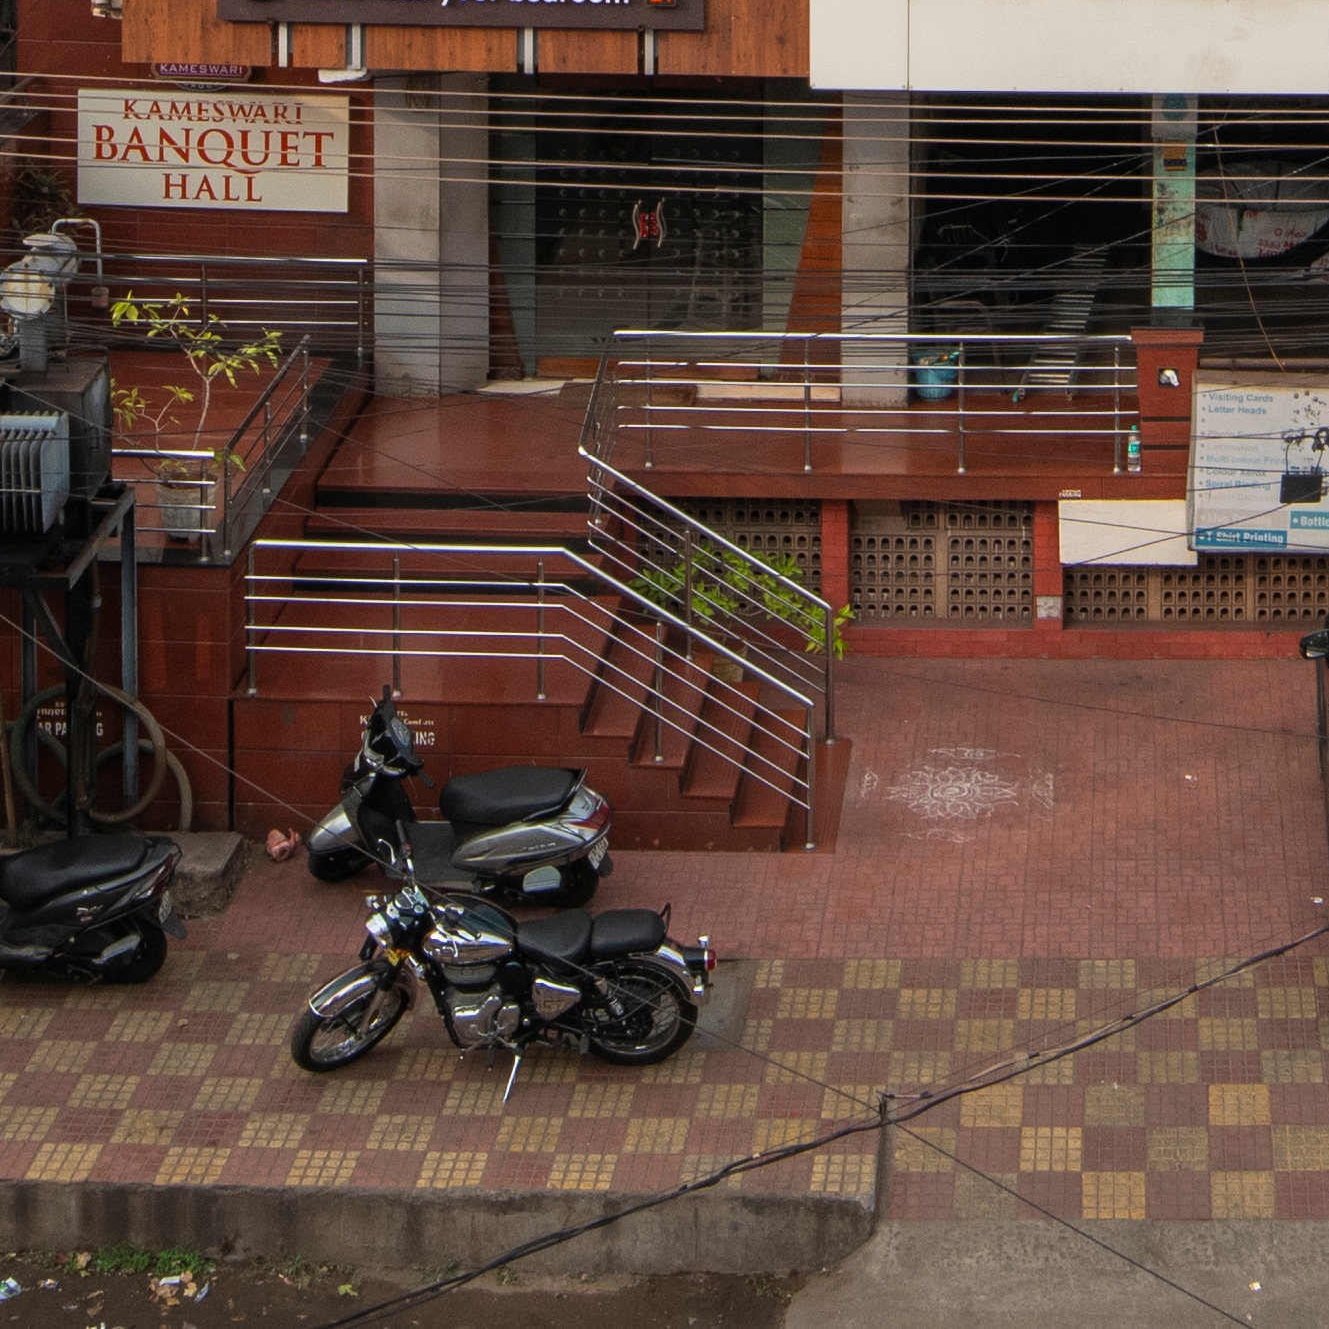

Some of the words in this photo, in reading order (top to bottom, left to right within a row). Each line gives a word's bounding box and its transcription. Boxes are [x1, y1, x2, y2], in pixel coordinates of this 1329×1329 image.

[160, 64, 242, 77] KAMESWARI
[123, 97, 304, 125] KAMESWARI
[92, 125, 335, 173] BANQUET
[163, 173, 262, 202] HALL
[1208, 393, 1244, 403] Visiting
[1246, 394, 1275, 403] Cards
[1208, 405, 1235, 415] Letter
[1237, 406, 1268, 415] Heads
[1243, 533, 1284, 544] Printing
